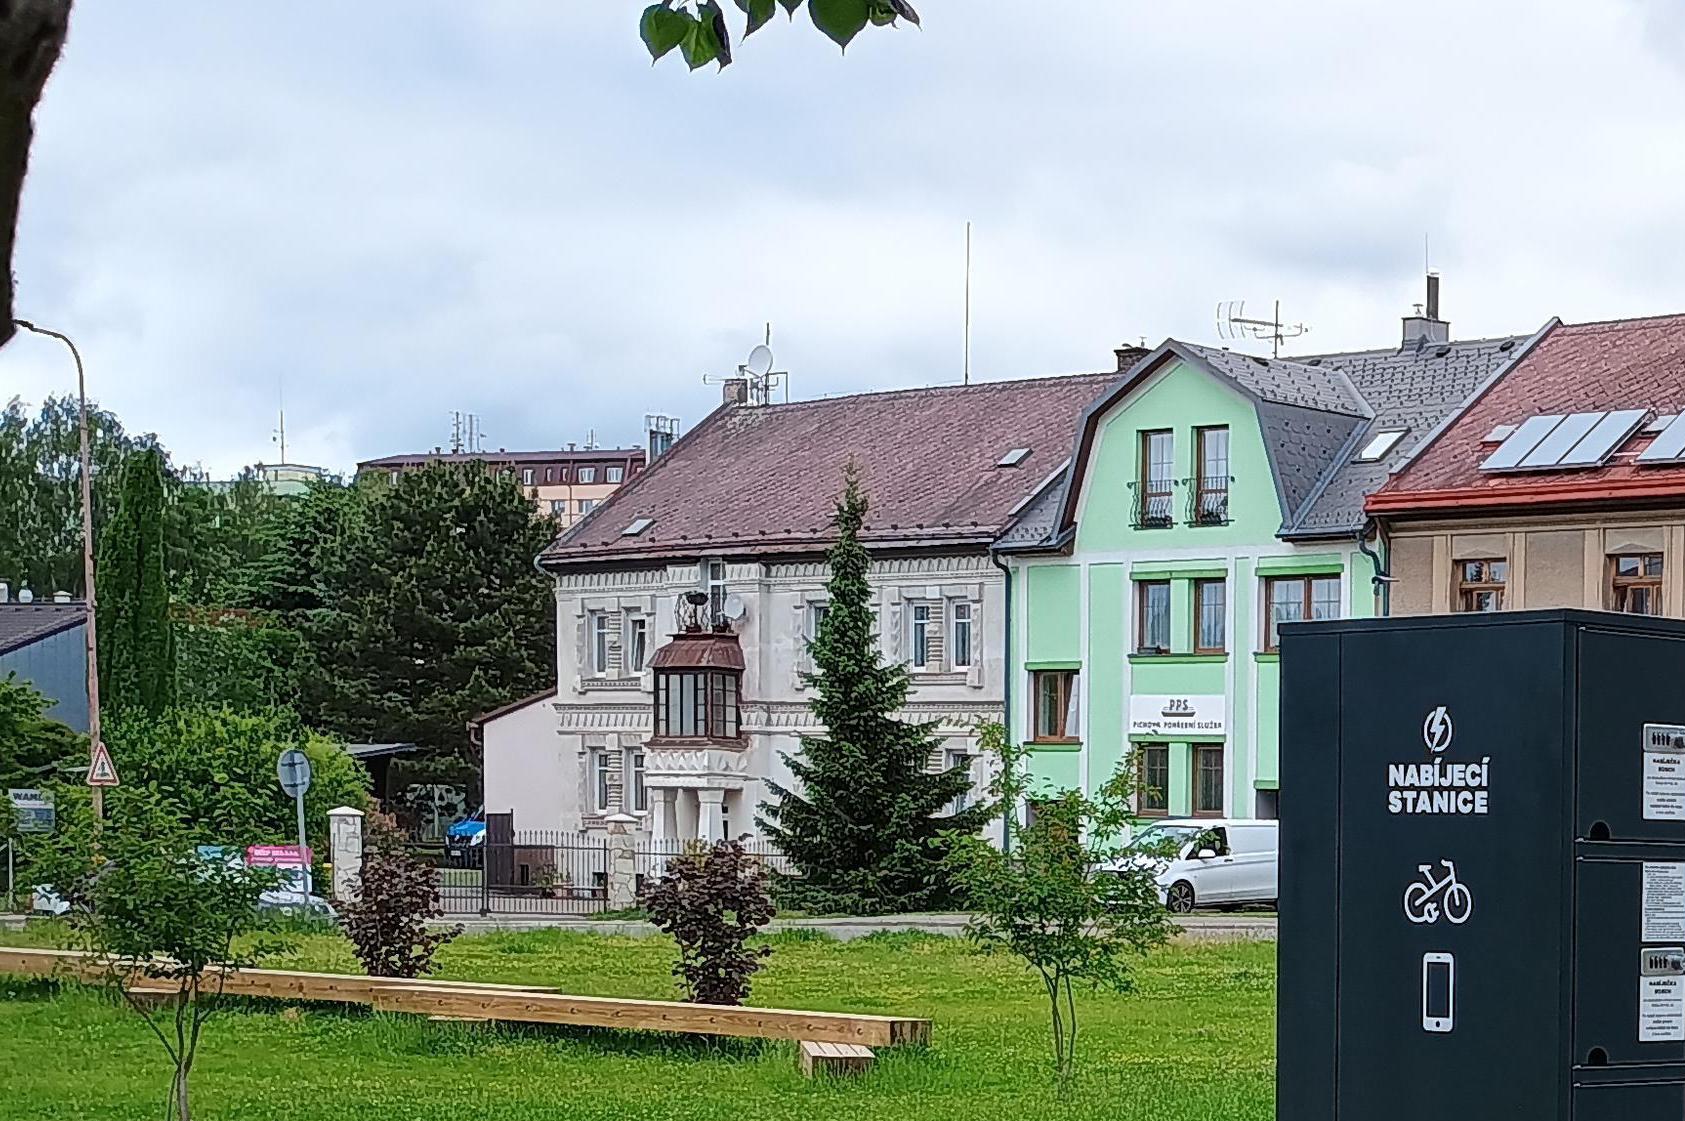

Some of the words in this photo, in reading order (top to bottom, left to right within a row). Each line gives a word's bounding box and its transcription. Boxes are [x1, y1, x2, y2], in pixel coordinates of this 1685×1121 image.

[1169, 699, 1189, 711] PPS
[1388, 757, 1490, 787] NABÍJECÍ
[1388, 790, 1488, 814] STANICE
